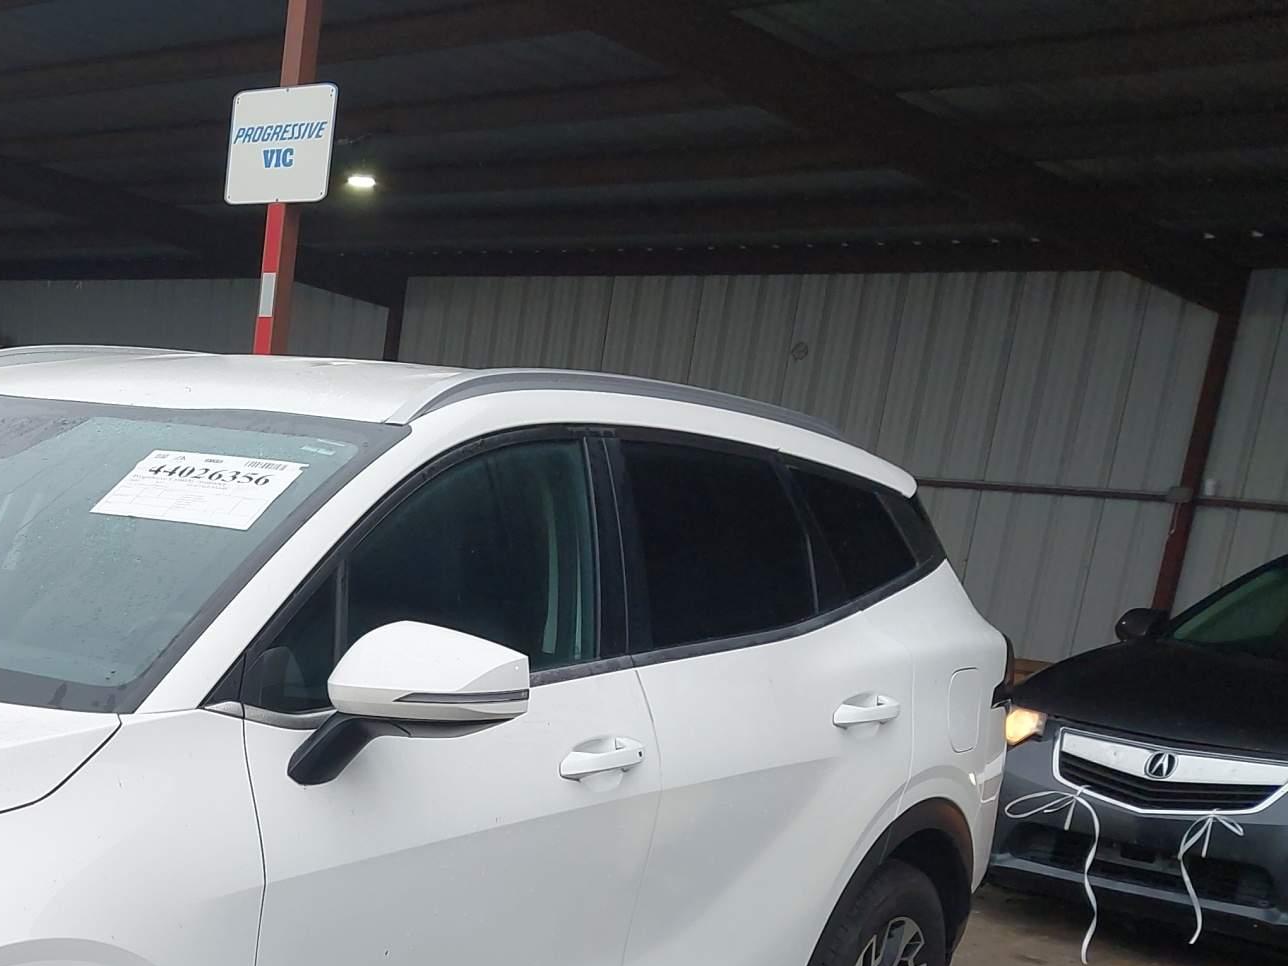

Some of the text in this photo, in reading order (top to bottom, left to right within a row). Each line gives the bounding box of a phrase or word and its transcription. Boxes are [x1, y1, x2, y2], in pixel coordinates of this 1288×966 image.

[233, 121, 328, 144] PROGRESSIVE
[263, 147, 294, 168] VIC
[148, 464, 274, 486] 44026356
